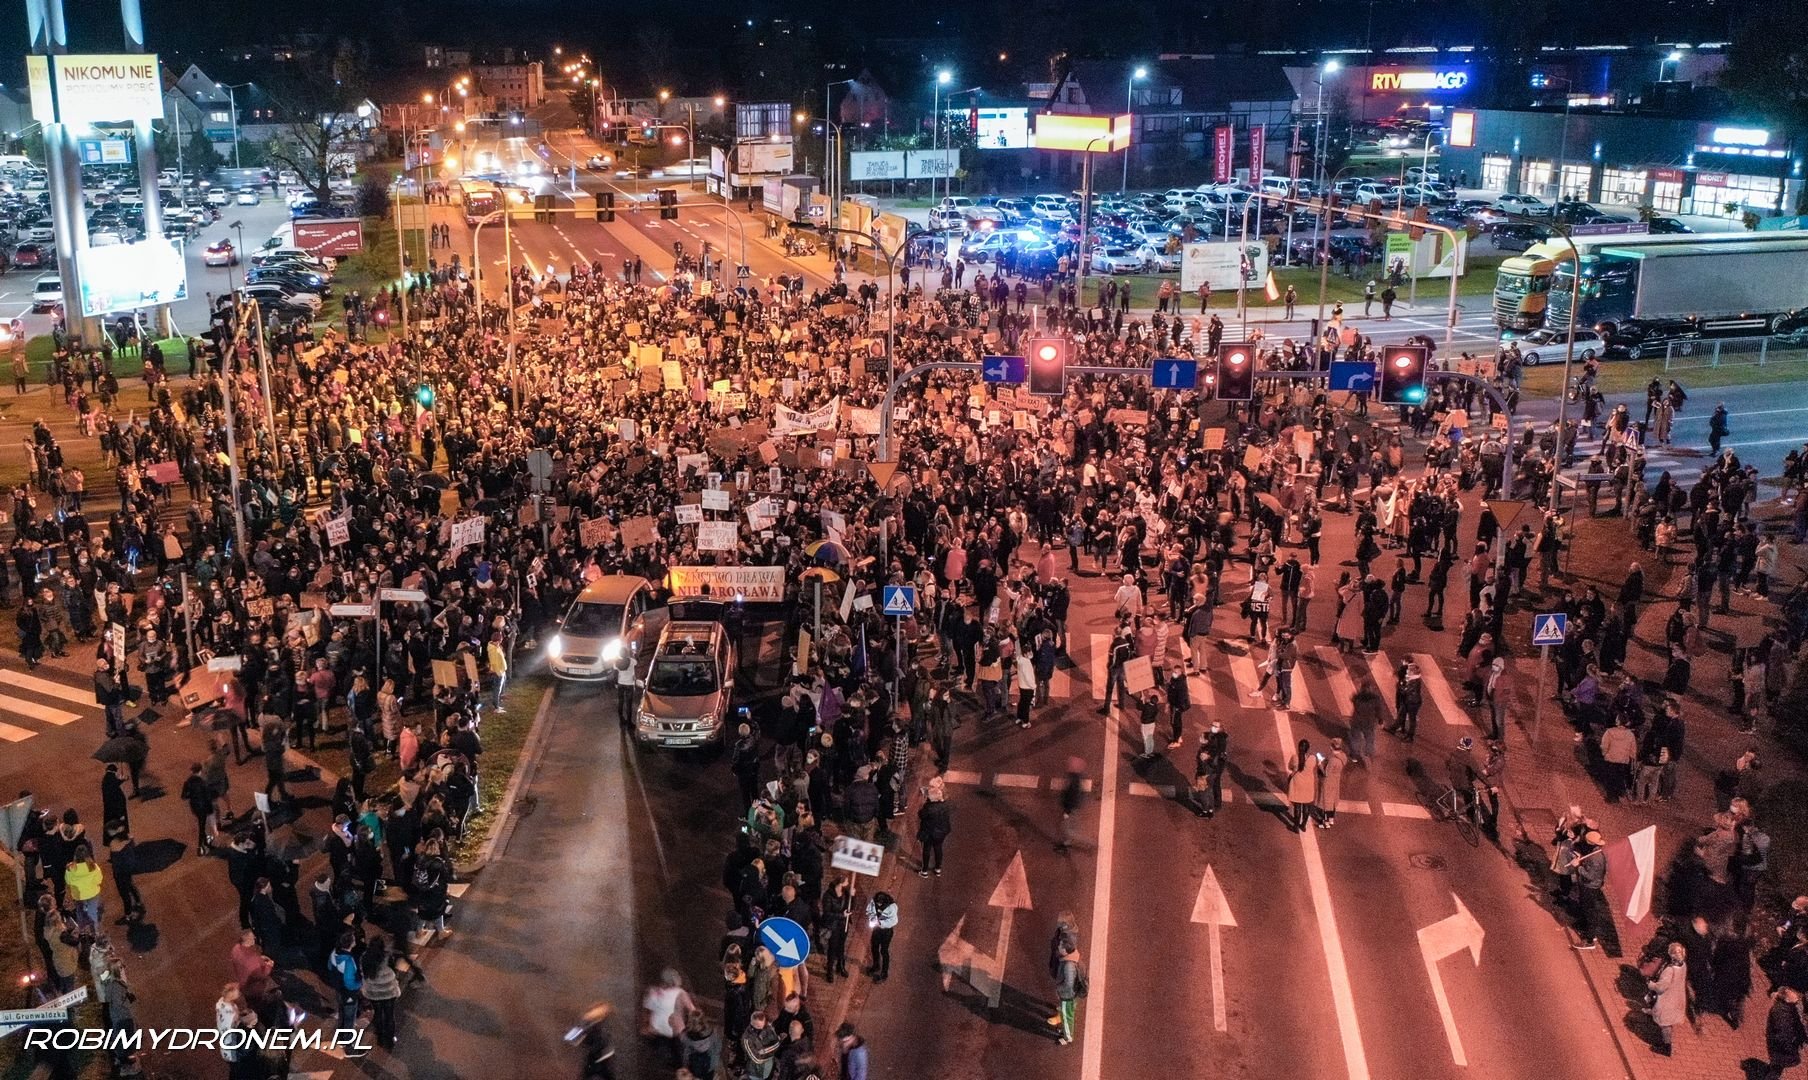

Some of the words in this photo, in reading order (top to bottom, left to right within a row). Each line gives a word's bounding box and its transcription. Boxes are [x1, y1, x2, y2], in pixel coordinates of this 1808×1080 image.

[64, 66, 125, 80] NIKOMU
[130, 65, 153, 79] NIE
[1372, 73, 1401, 89] RTV
[1435, 72, 1468, 89] AGD
[677, 568, 733, 584] PAŃSTWO
[736, 570, 776, 583] PRAWA
[678, 585, 698, 597] NIE
[709, 585, 779, 598] AROSŁAWA
[15, 1011, 66, 1020] Grunwaldzka
